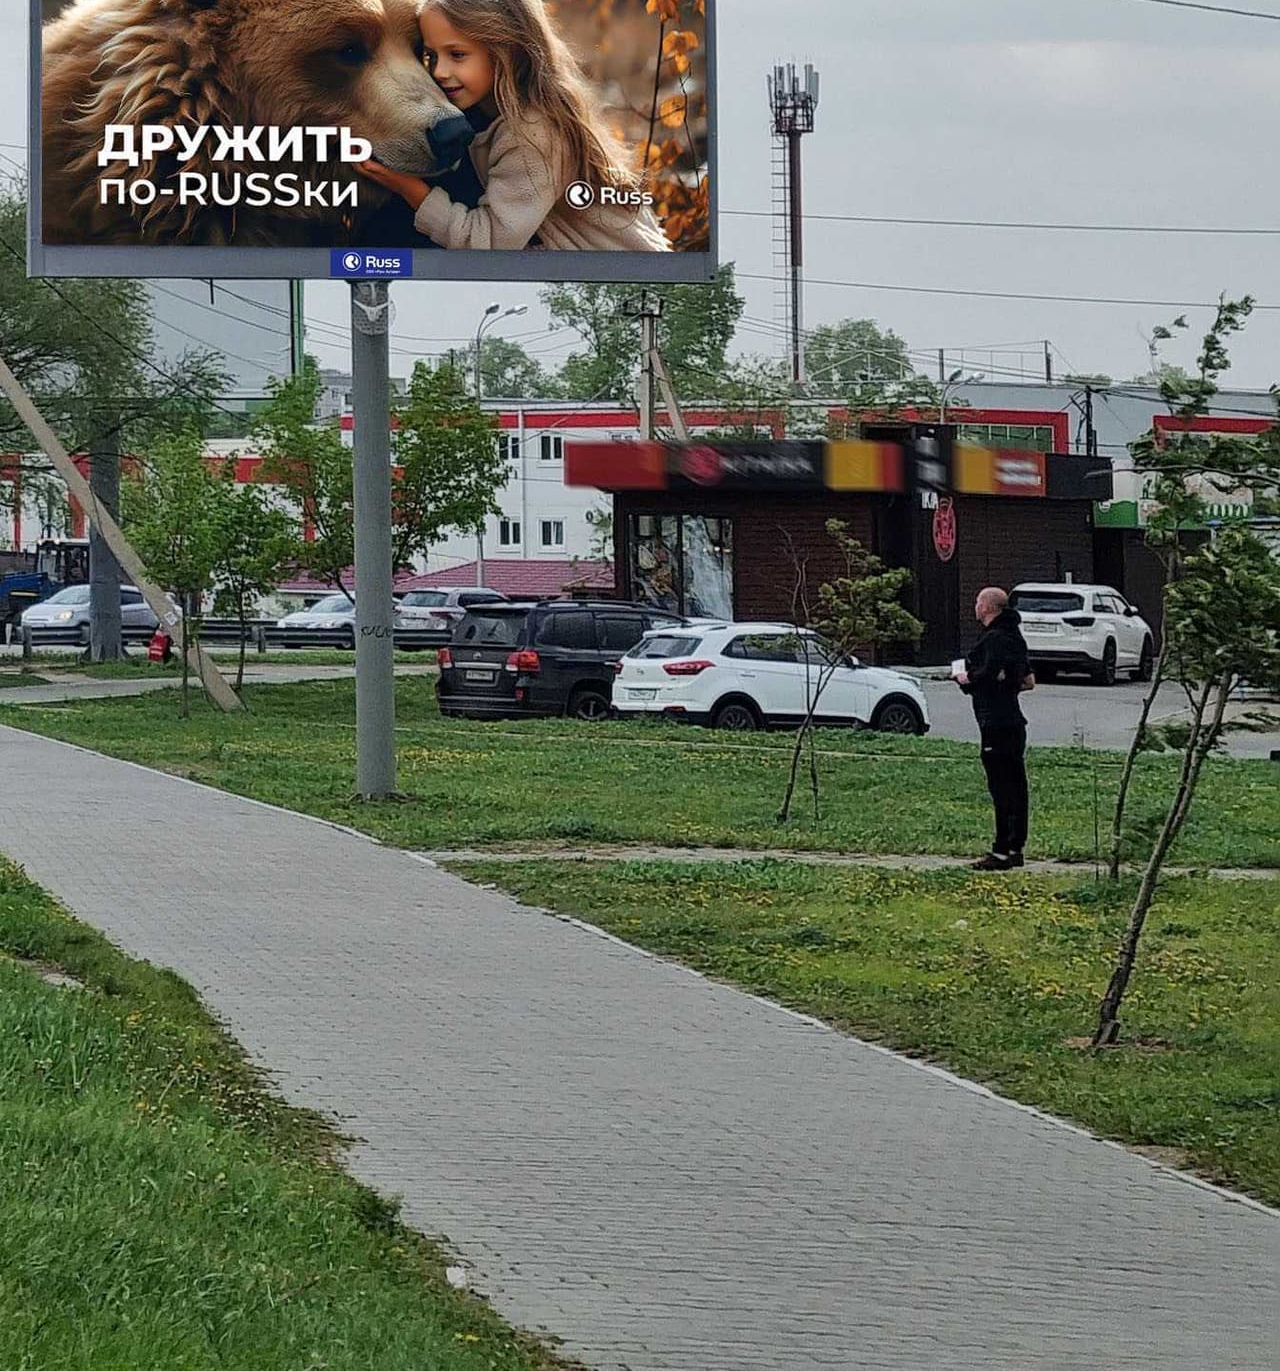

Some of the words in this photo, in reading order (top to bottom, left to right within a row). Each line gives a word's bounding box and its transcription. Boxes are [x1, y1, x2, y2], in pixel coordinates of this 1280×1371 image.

[97, 123, 373, 167] ДРУЖИТЬ
[100, 172, 359, 207] по-RUSSки
[600, 186, 654, 205] Russ
[365, 255, 401, 268] Russ
